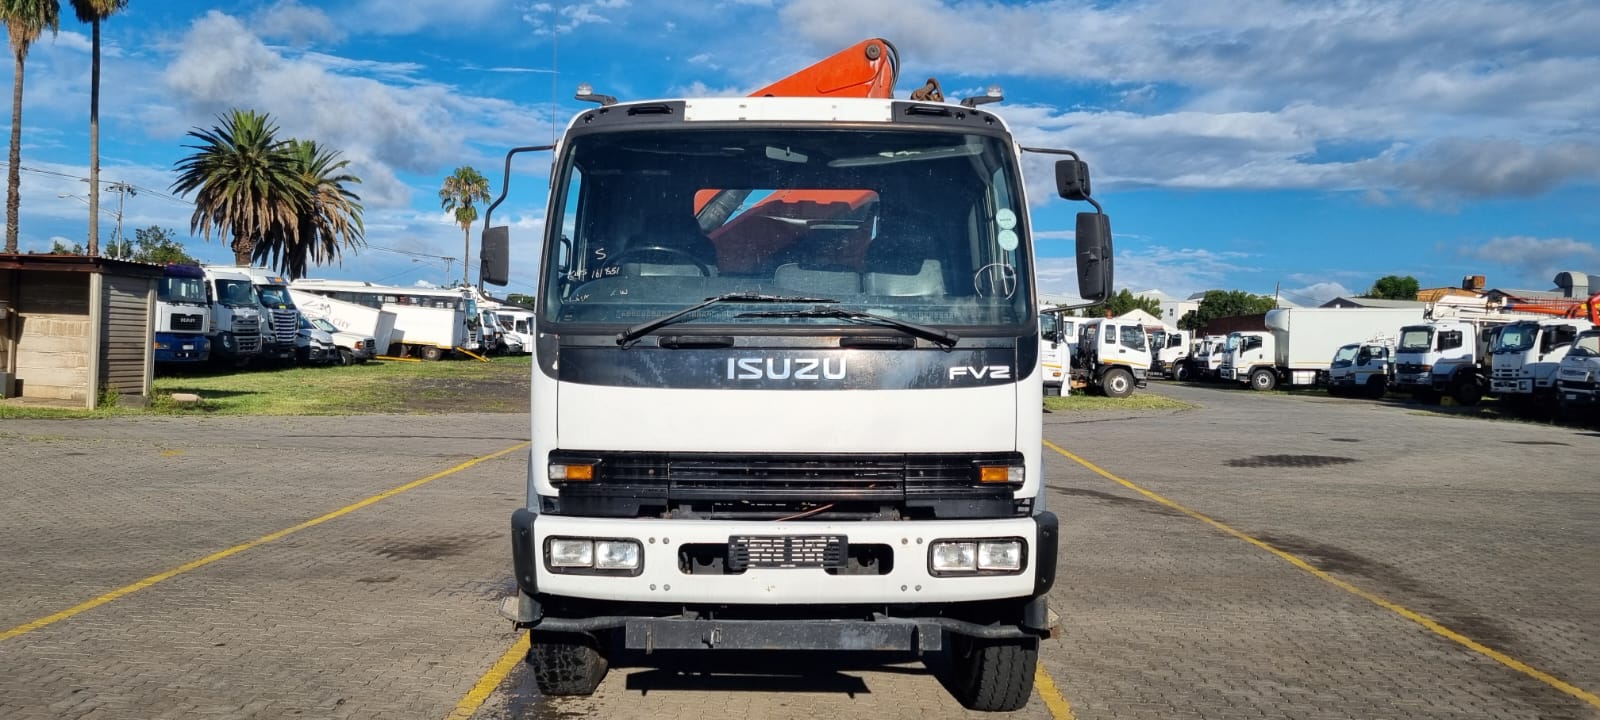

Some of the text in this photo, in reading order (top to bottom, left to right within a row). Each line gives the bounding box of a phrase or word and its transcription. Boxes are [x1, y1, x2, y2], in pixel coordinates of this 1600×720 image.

[595, 247, 607, 260] S
[727, 358, 847, 380] ISUZU
[949, 365, 1011, 380] FVZ
